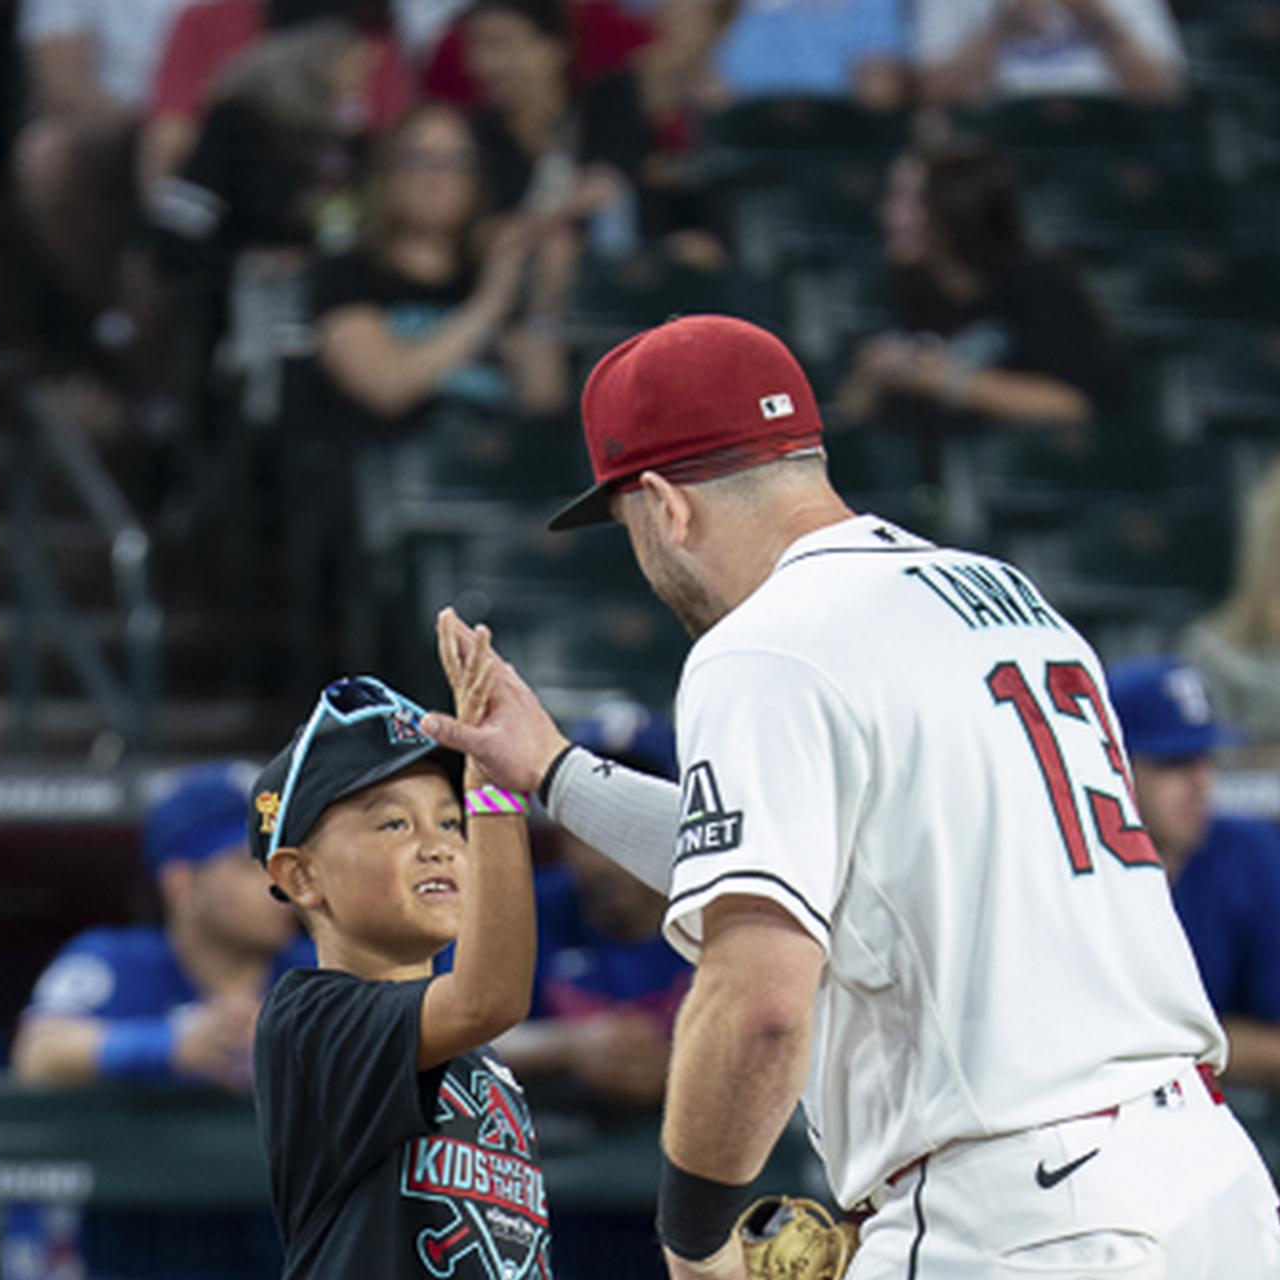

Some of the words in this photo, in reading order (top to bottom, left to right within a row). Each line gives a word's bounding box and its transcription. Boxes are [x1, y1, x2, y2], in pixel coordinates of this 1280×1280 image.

[902, 562, 1065, 632] TAWA
[984, 658, 1164, 876] 13
[414, 1138, 491, 1194] KIDS
[493, 1175, 525, 1204] THE
